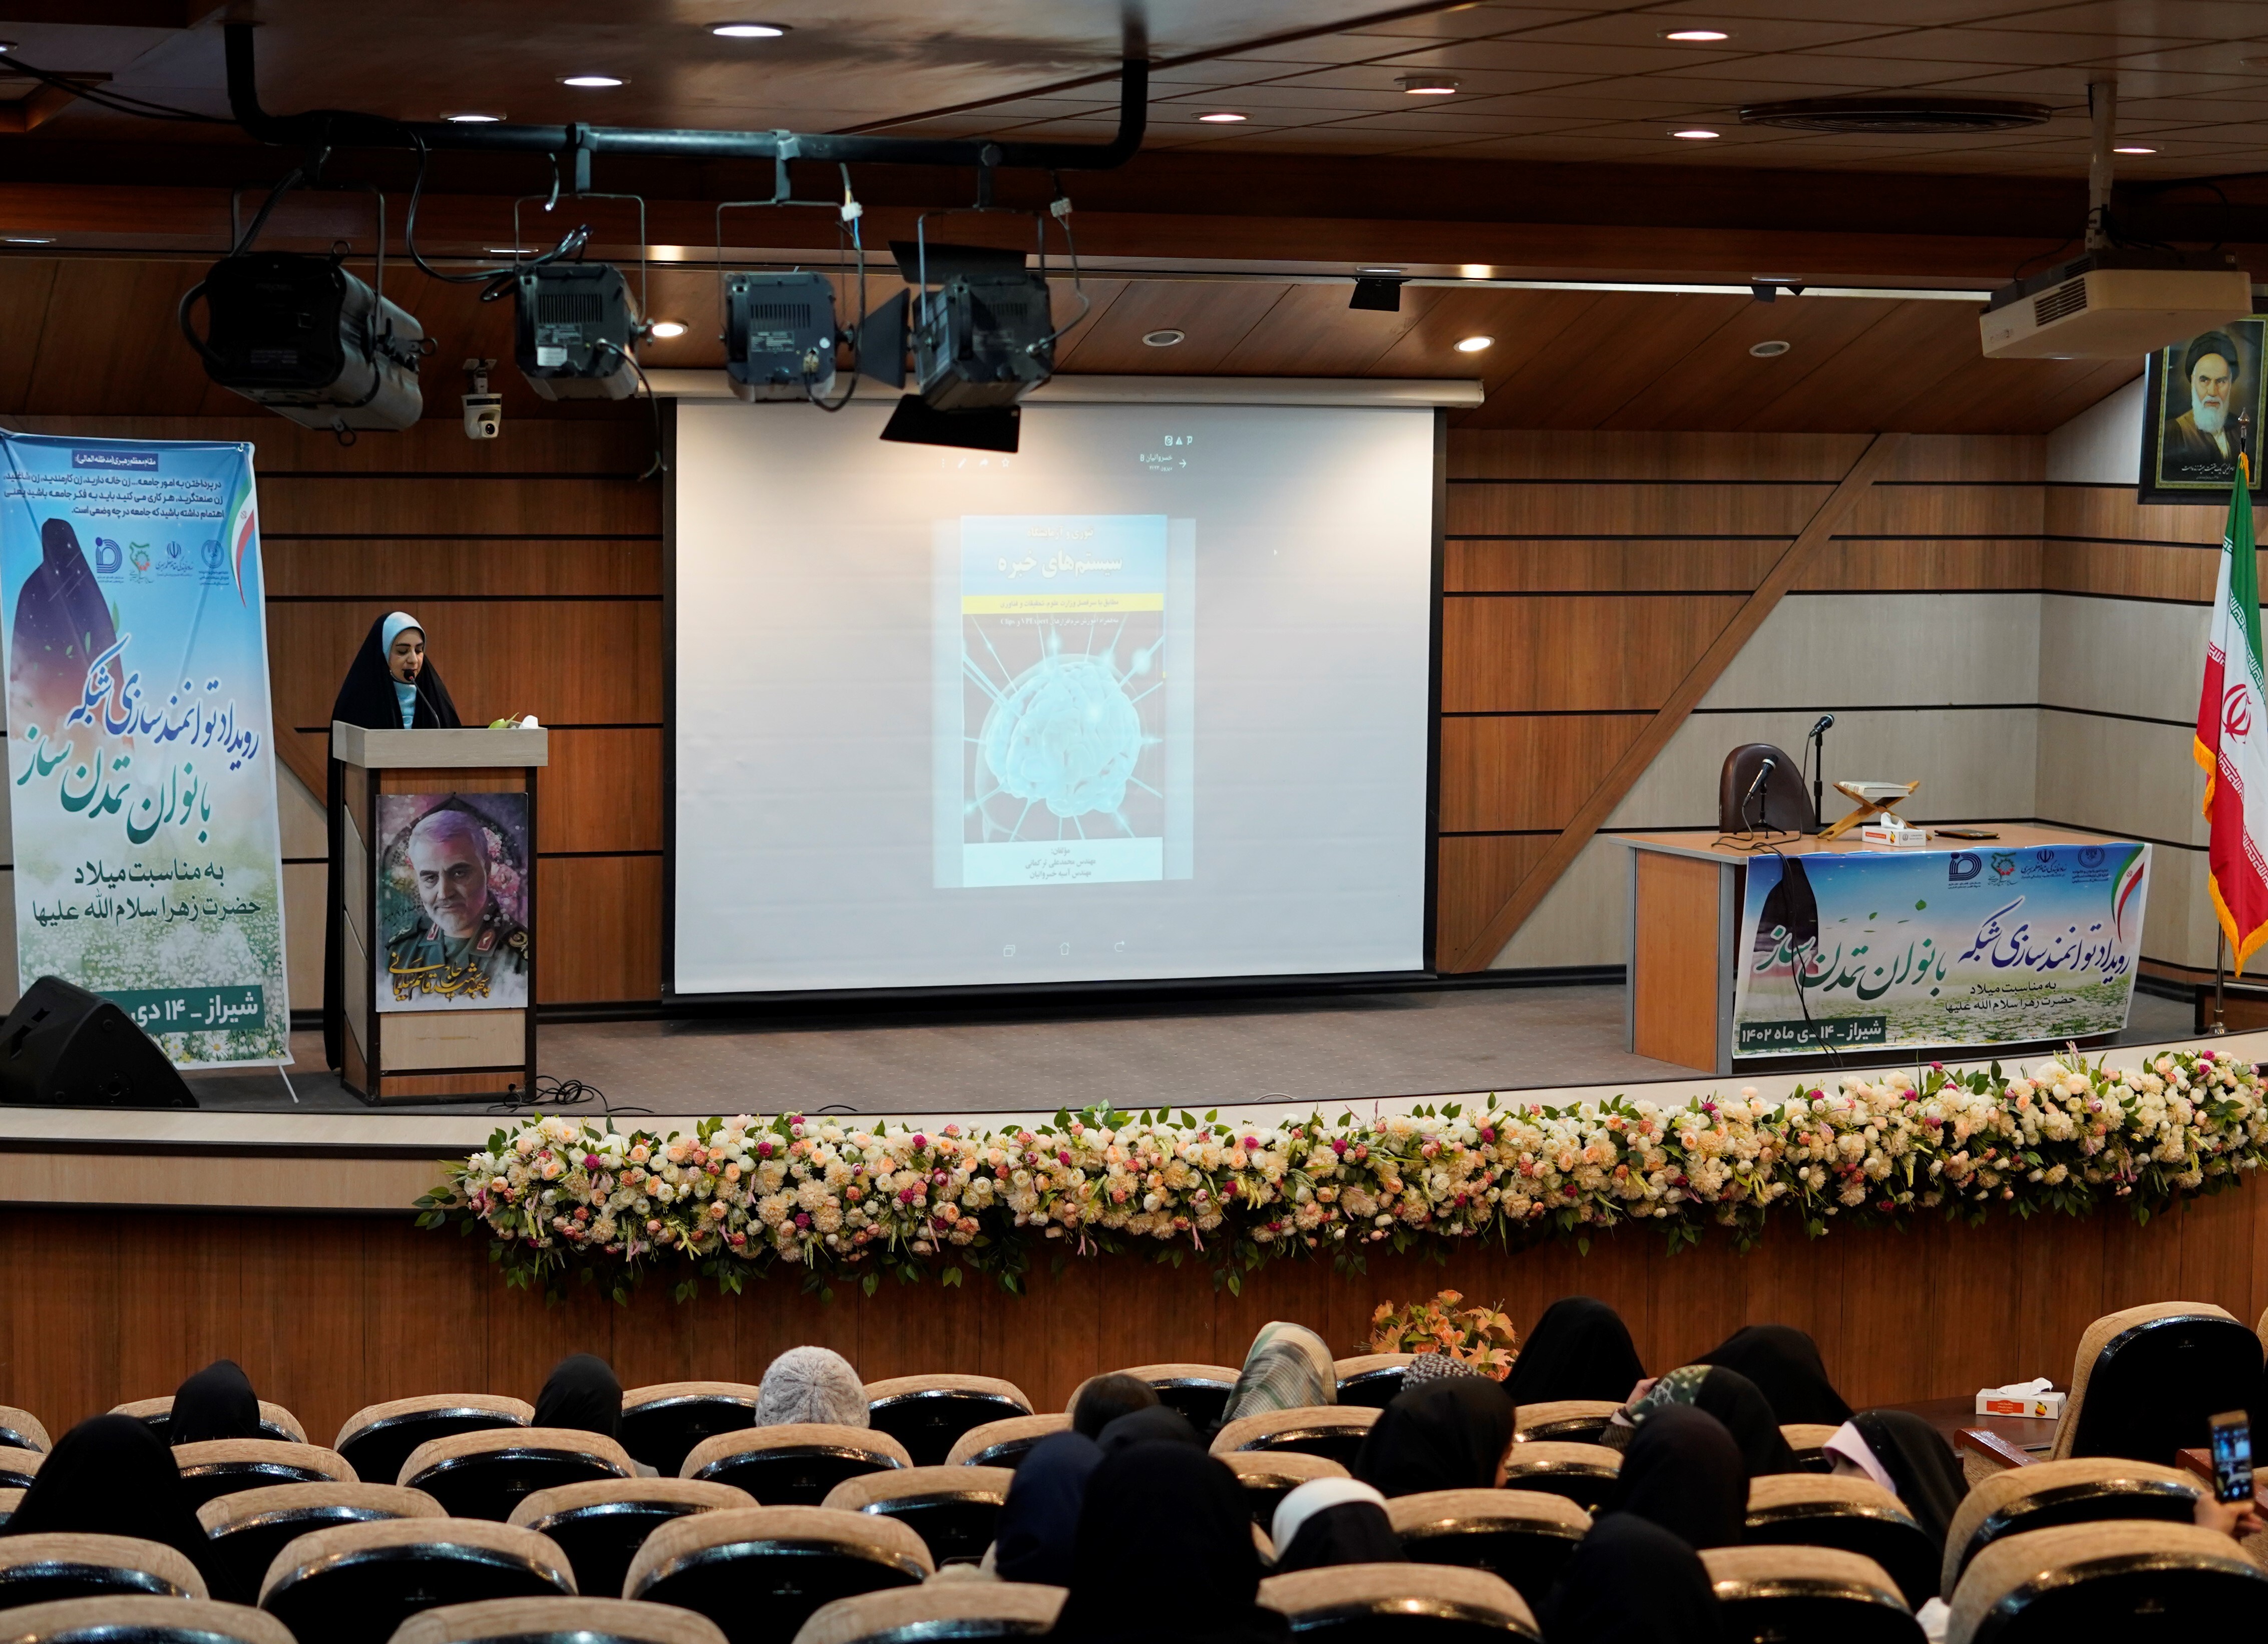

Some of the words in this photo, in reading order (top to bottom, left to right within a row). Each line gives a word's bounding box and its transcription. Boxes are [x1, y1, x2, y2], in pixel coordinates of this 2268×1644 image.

[31, 474, 40, 483] زن
[74, 476, 83, 485] زن
[105, 476, 121, 485] خانه
[122, 478, 131, 487] زن
[160, 478, 175, 489] امور
[176, 480, 184, 489] به
[185, 479, 214, 492] پرداختن
[214, 482, 221, 490] در
[4, 488, 25, 498] یعنی
[27, 488, 48, 500] باشید
[49, 489, 72, 501] جامعه
[73, 490, 87, 501] فکر
[89, 491, 98, 501] به
[99, 491, 116, 502] باید
[116, 491, 133, 502] کنید
[134, 495, 147, 503] می
[147, 493, 162, 503] کاری
[162, 495, 175, 504] هر
[214, 496, 223, 505] زن
[90, 506, 111, 517] وضعی
[112, 508, 121, 519] چه
[122, 509, 130, 518] در
[131, 507, 151, 518] جامعه
[152, 508, 160, 517] که
[161, 507, 179, 519] باشید
[180, 508, 199, 518] داشته
[200, 509, 225, 520] اهتمام
[1066, 530, 1070, 540] و
[997, 549, 1037, 579] خبره
[67, 634, 129, 726] شبکه
[217, 701, 259, 770] رویداد
[17, 726, 71, 786] ساز
[61, 748, 131, 818] تمدن
[127, 762, 210, 845] بانوان
[75, 859, 126, 889] میلاد
[129, 858, 201, 889] مناسبت
[204, 861, 224, 887] به
[84, 888, 113, 919] الله
[161, 895, 198, 923] زهرا
[202, 897, 261, 921] حضرت
[33, 899, 79, 927] علیها
[116, 896, 158, 926] سلام
[1957, 898, 2023, 964] شبکه
[1755, 927, 1815, 971] ساز
[1798, 942, 1869, 992] تمدن
[2095, 937, 2131, 984] رویداد
[1856, 938, 1947, 1000] بانوان
[1970, 983, 2000, 996] میلاد
[2002, 981, 2043, 995] مناسبت
[2045, 981, 2056, 992] به
[205, 991, 258, 1024] شیراز
[1945, 1001, 1971, 1014] علیها
[1974, 996, 1991, 1010] الله
[1993, 999, 2018, 1013] سلام
[2020, 996, 2039, 1010] زهرا
[2041, 996, 2077, 1007] حضرت
[1742, 1028, 1772, 1043] ۱۴۰۲
[1774, 1026, 1794, 1039] ماه
[1846, 1020, 1881, 1041] شیراز
